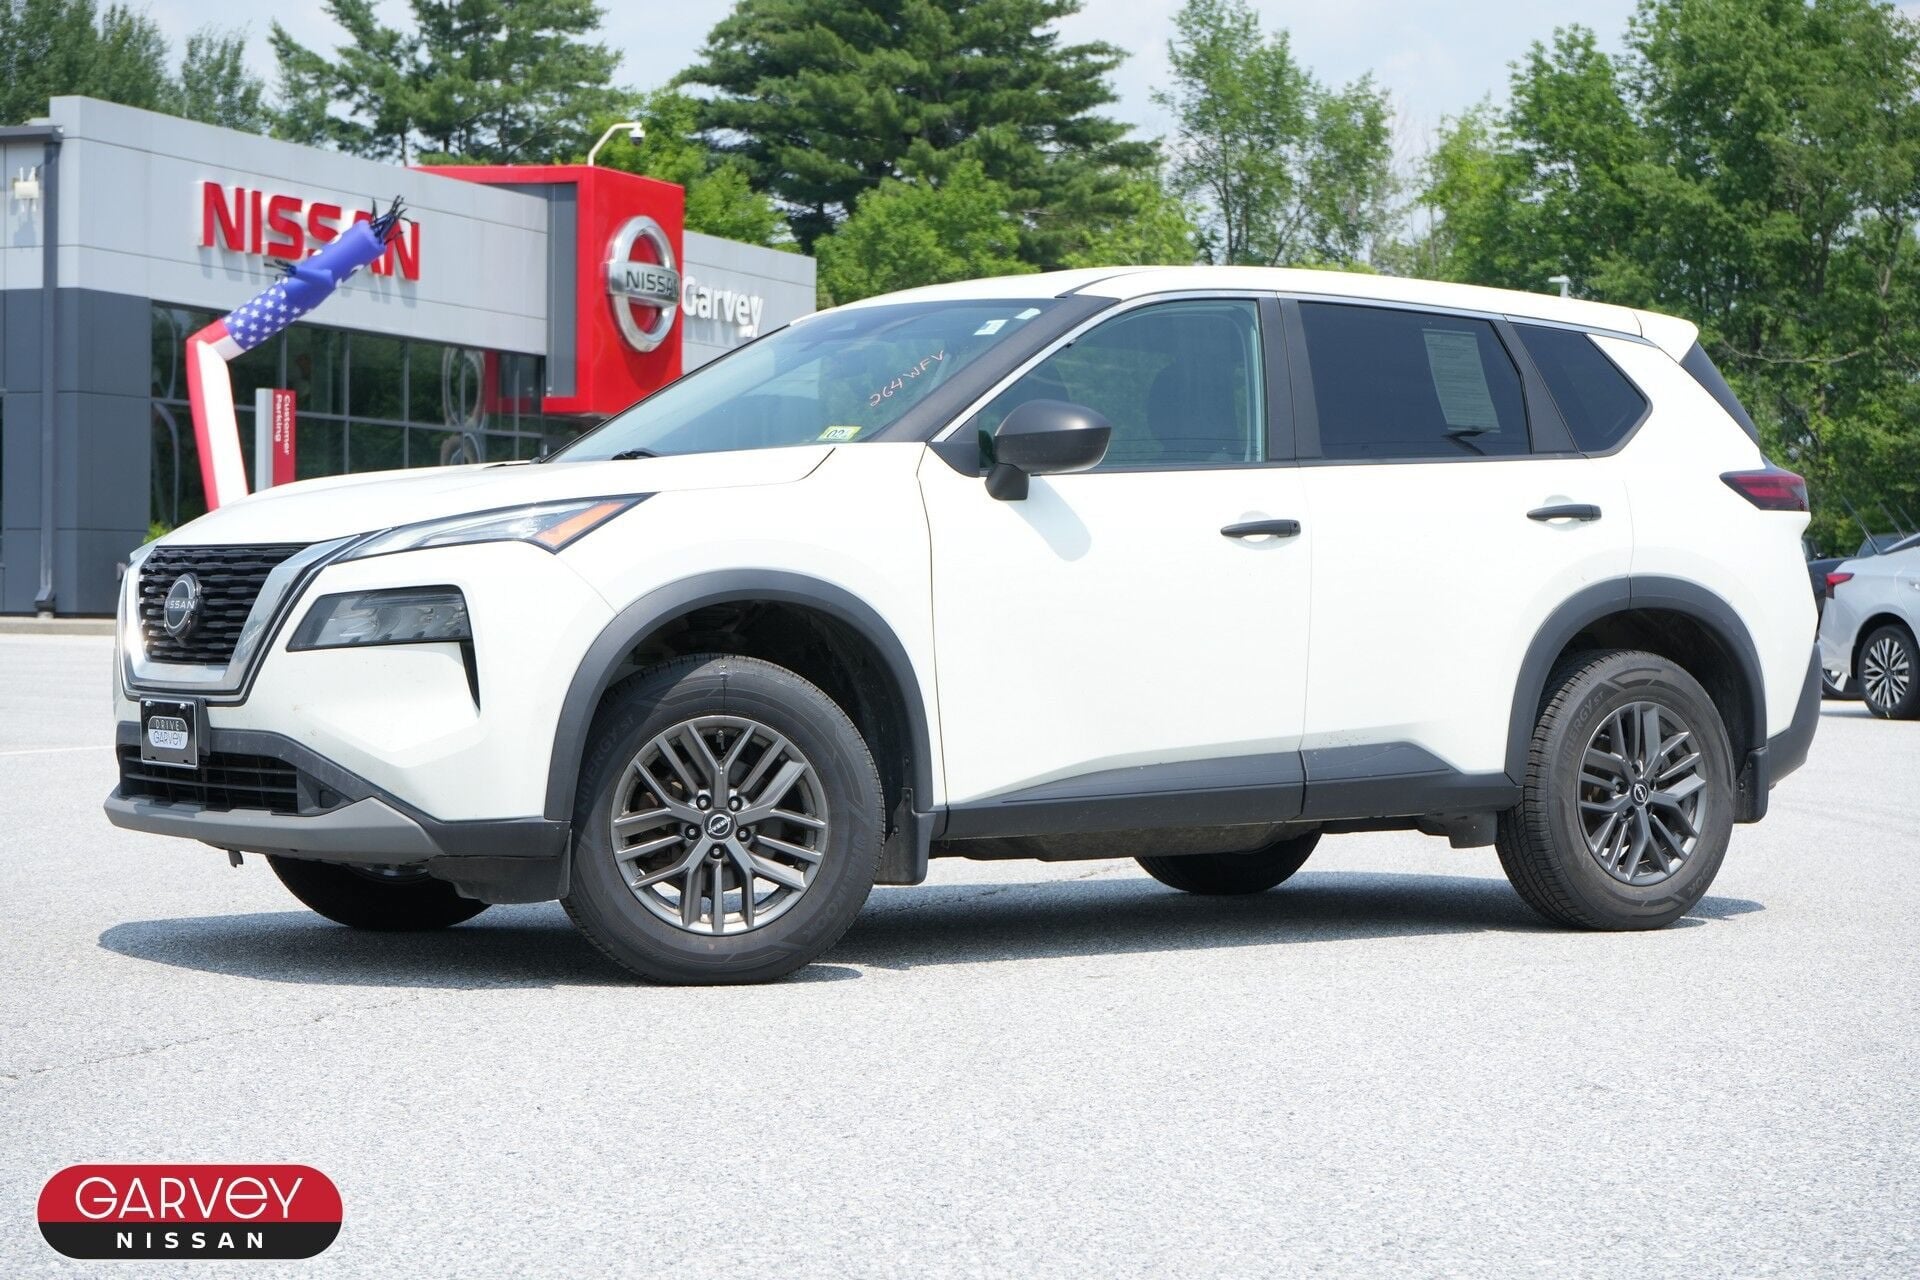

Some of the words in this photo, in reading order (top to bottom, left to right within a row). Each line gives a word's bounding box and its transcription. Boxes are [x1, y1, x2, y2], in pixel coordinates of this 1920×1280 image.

[681, 275, 764, 338] Garvey
[283, 395, 291, 455] Customer
[167, 600, 195, 609] SSAN
[155, 719, 180, 731] DRIVE
